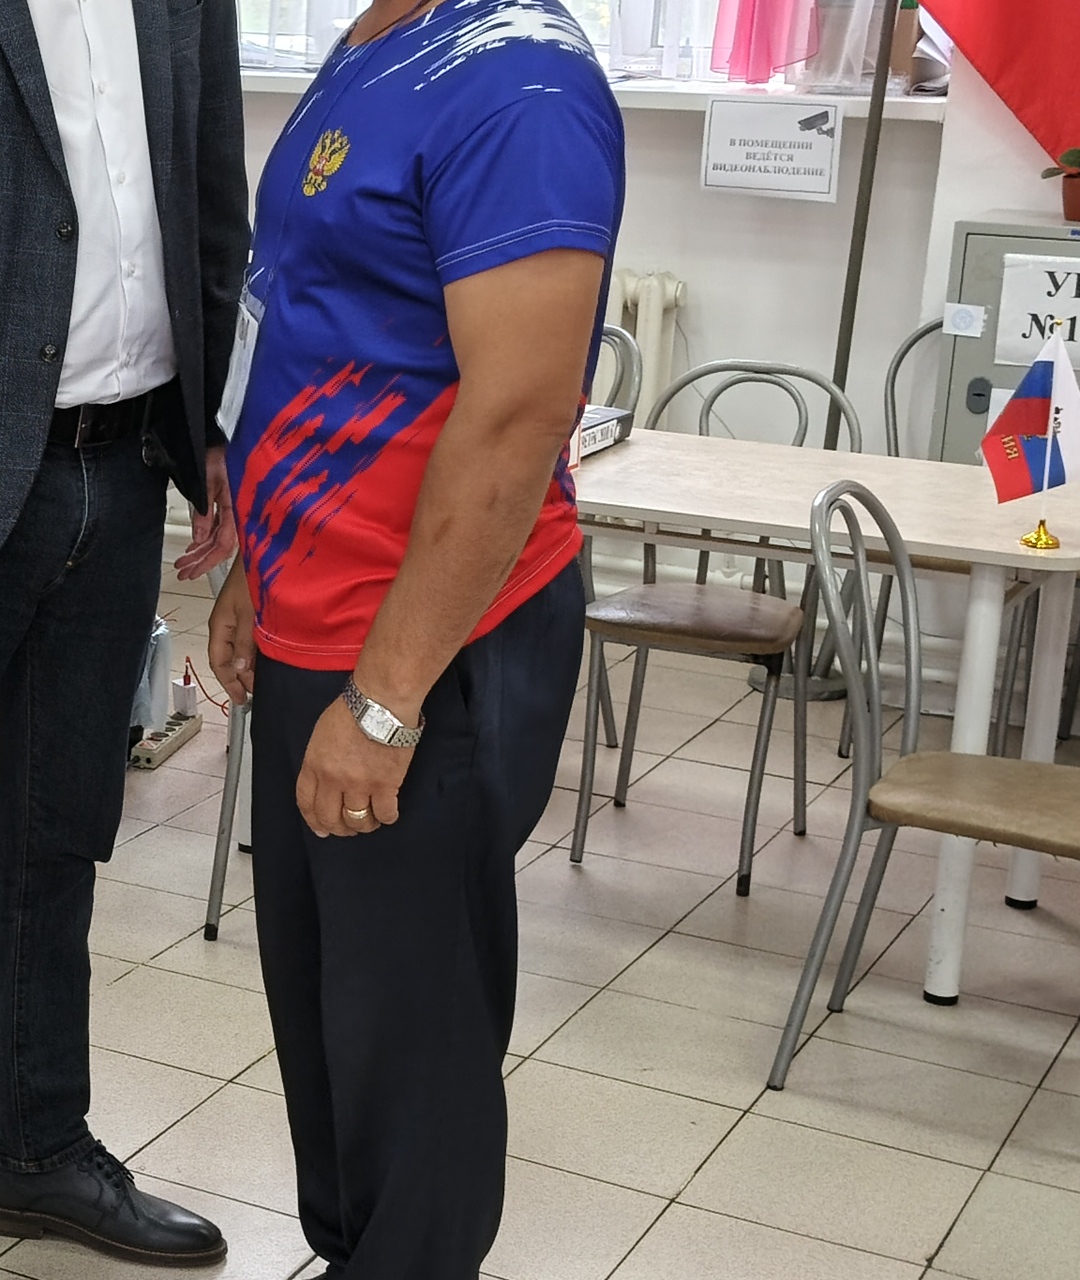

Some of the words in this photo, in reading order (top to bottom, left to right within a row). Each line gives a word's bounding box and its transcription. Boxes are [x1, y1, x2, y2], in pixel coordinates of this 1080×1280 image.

[729, 138, 736, 147] В
[738, 138, 813, 150] ПОМЕЩЕНИИ
[745, 151, 794, 162] ВЕДЁТСЯ
[712, 162, 826, 177] ВИДЕОНАБЛЮДЕНИЕ
